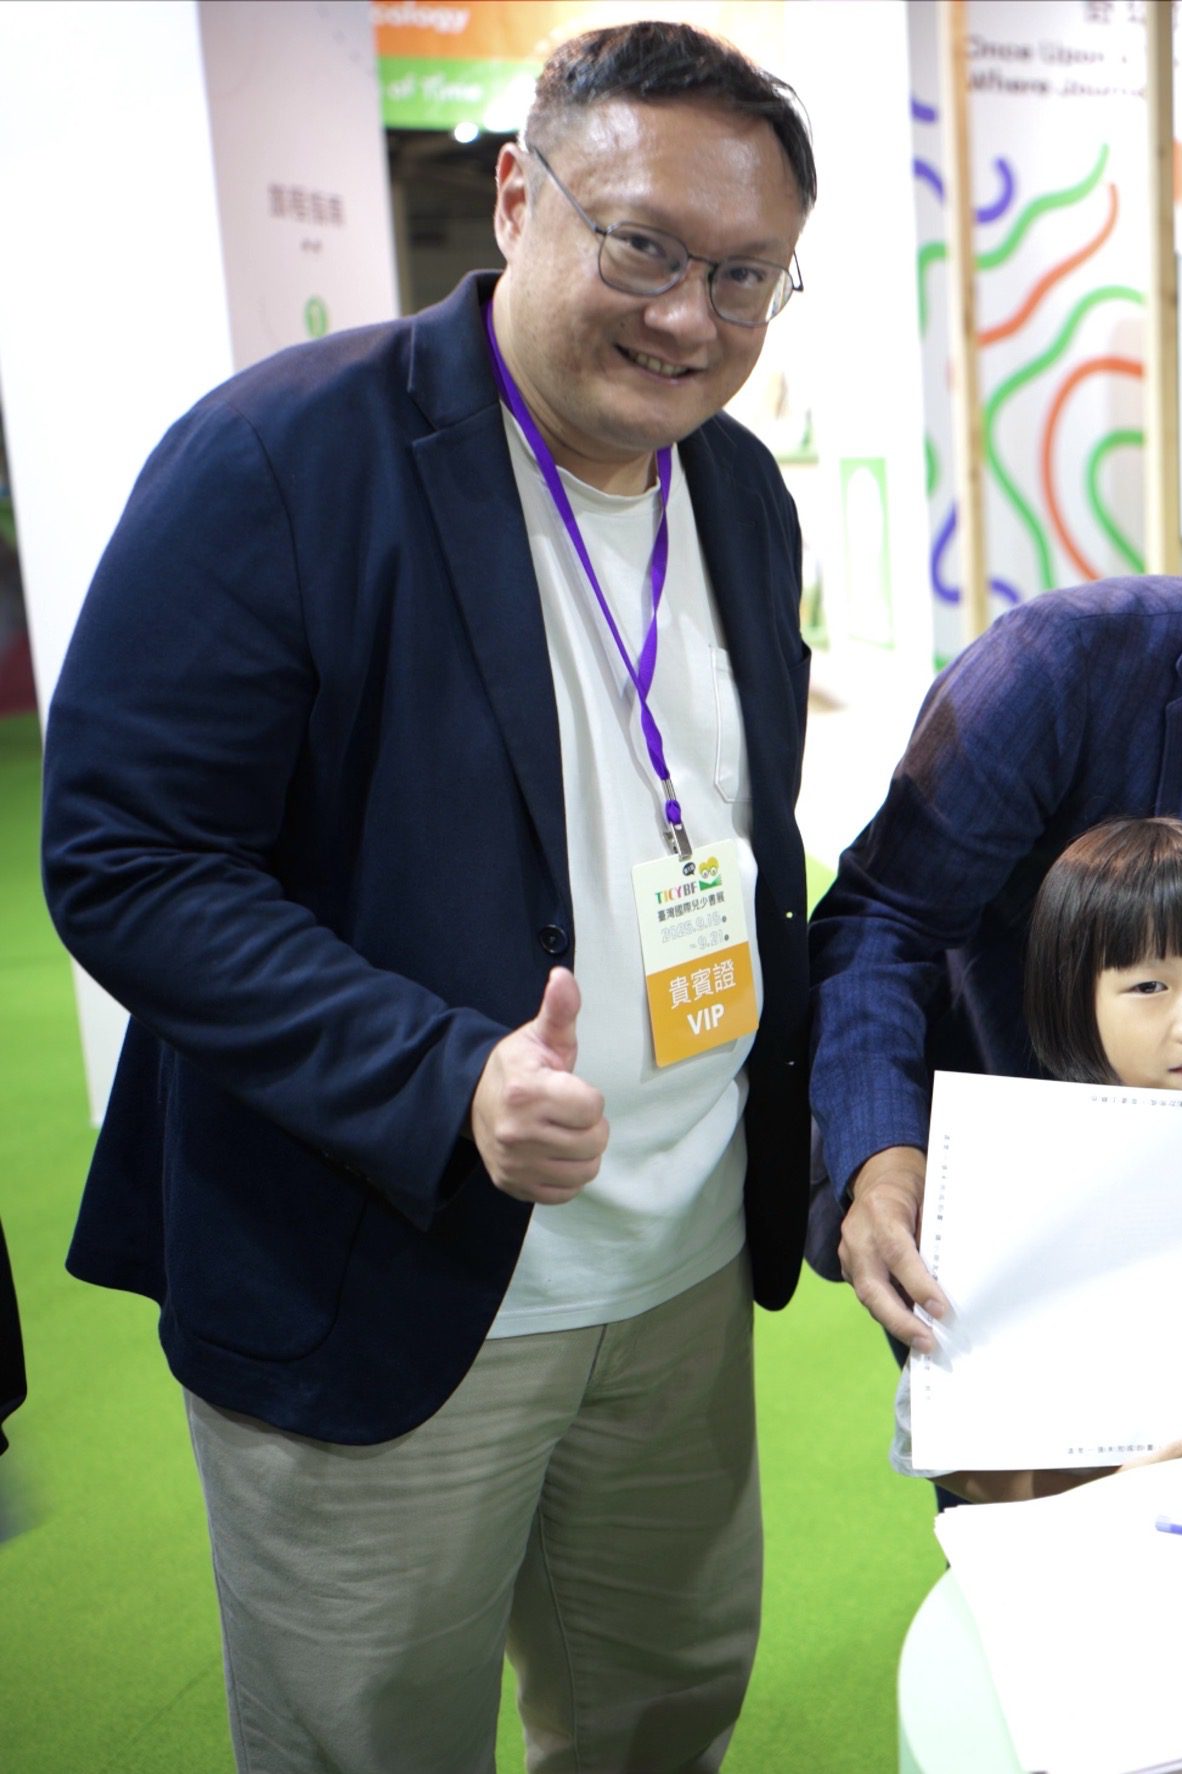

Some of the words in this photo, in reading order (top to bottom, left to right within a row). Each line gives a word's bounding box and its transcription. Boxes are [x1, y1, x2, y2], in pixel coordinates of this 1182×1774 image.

[655, 881, 698, 905] TICYBF
[657, 891, 725, 922] 臺灣國際兒少書展
[668, 959, 736, 1009] 貴賓證
[687, 1003, 725, 1036] VIP
